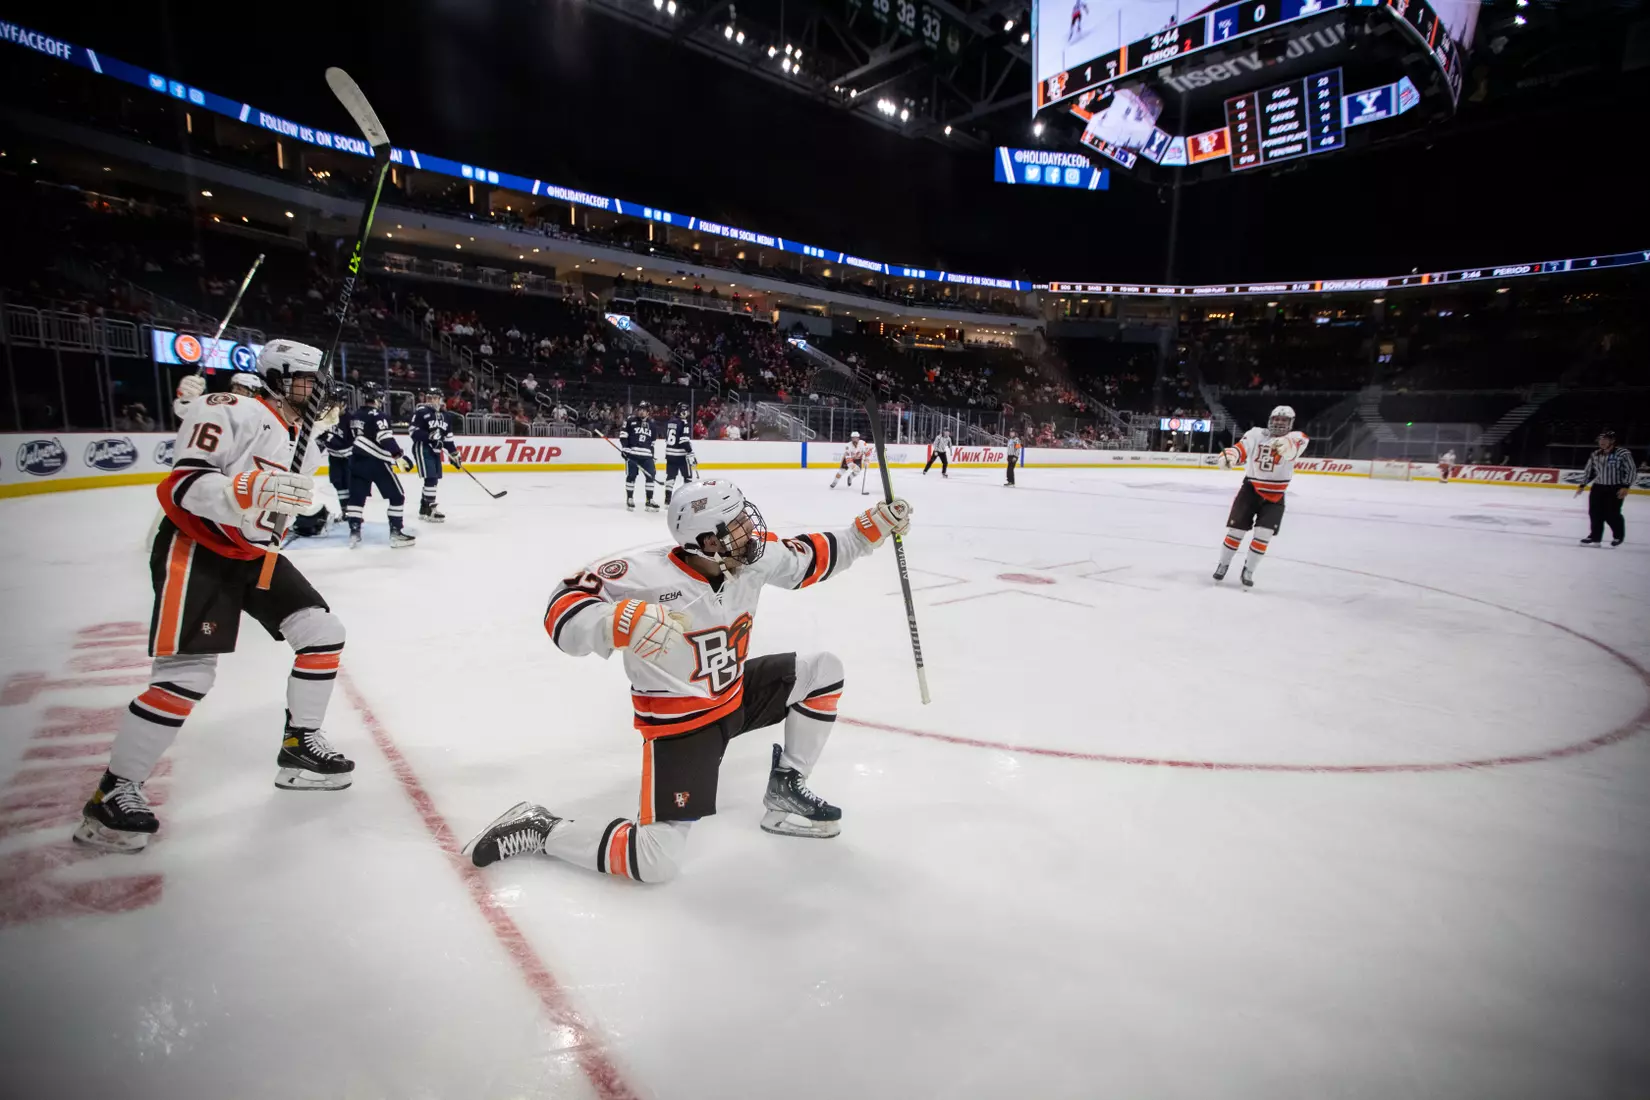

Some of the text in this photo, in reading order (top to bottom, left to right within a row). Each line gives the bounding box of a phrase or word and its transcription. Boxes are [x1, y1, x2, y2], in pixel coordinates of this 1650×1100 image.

[1253, 3, 1266, 23] 0
[922, 13, 941, 43] 33
[1221, 28, 1230, 40] 1
[1150, 27, 1180, 51] 3:44
[1141, 38, 1193, 67] PERIOD 2
[1084, 66, 1093, 83] 1
[1108, 69, 1117, 80] 1
[259, 112, 299, 137] FOLLOW
[299, 126, 315, 143] US
[315, 131, 333, 148] ON
[334, 134, 369, 156] SOCIAL
[1268, 120, 1300, 136] BLOCKS
[546, 185, 610, 209] @HOLIDAYFACEOFF
[699, 220, 722, 235] FOLLOW
[721, 226, 730, 237] US
[730, 228, 739, 239] ON
[738, 230, 757, 243] SOCIAL
[1492, 265, 1532, 277] PERIOD
[947, 273, 966, 283] FOLLOW
[966, 276, 973, 285] US
[981, 277, 996, 287] SOCIAL
[1322, 280, 1360, 291] BOWLING
[1359, 278, 1389, 290] GREEN
[334, 276, 356, 324] ALPHA
[428, 419, 449, 432] YALE
[186, 422, 224, 453] 16
[505, 439, 563, 463] TRIP
[951, 446, 1005, 463] KWIK TRIP
[1318, 459, 1353, 473] TRIP
[1457, 465, 1510, 481] KWIK
[1508, 467, 1553, 483] TRIP
[659, 590, 683, 603] CCHA
